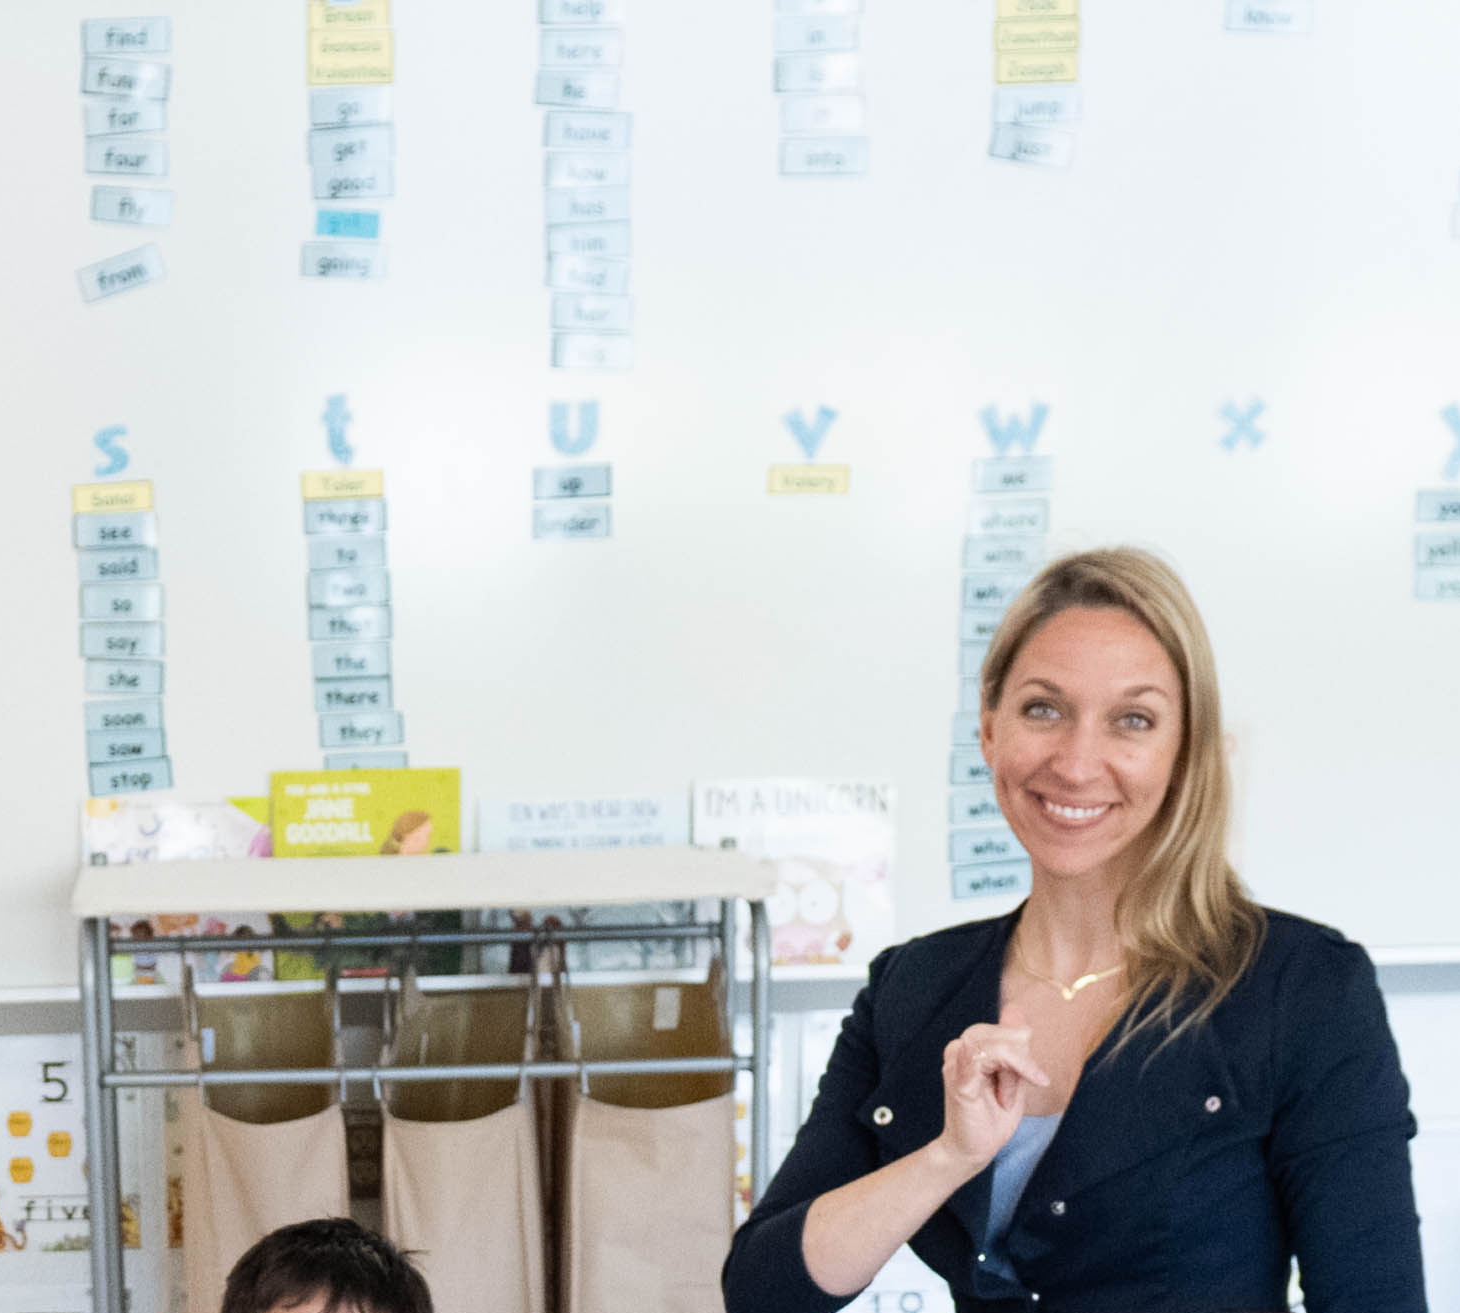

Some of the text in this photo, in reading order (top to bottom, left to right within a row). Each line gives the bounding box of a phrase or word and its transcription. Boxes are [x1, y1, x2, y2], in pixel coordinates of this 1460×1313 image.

[104, 27, 149, 48] find
[106, 105, 144, 129] for
[322, 394, 354, 466] t
[549, 399, 600, 456] u
[782, 403, 839, 461] v
[979, 402, 1051, 456] w
[1216, 399, 1268, 452] x
[93, 425, 130, 478] s
[97, 525, 133, 542] see
[334, 545, 359, 564] to
[97, 557, 140, 577] said
[110, 596, 133, 614] so
[104, 634, 139, 660] say
[106, 668, 142, 688] she
[324, 688, 381, 707] there
[101, 710, 147, 729] soon
[108, 736, 146, 756] saw
[338, 719, 385, 749] they
[109, 768, 155, 794] stop
[305, 798, 355, 821] JANE
[285, 822, 374, 846] GOODALL
[41, 1061, 70, 1104] 5
